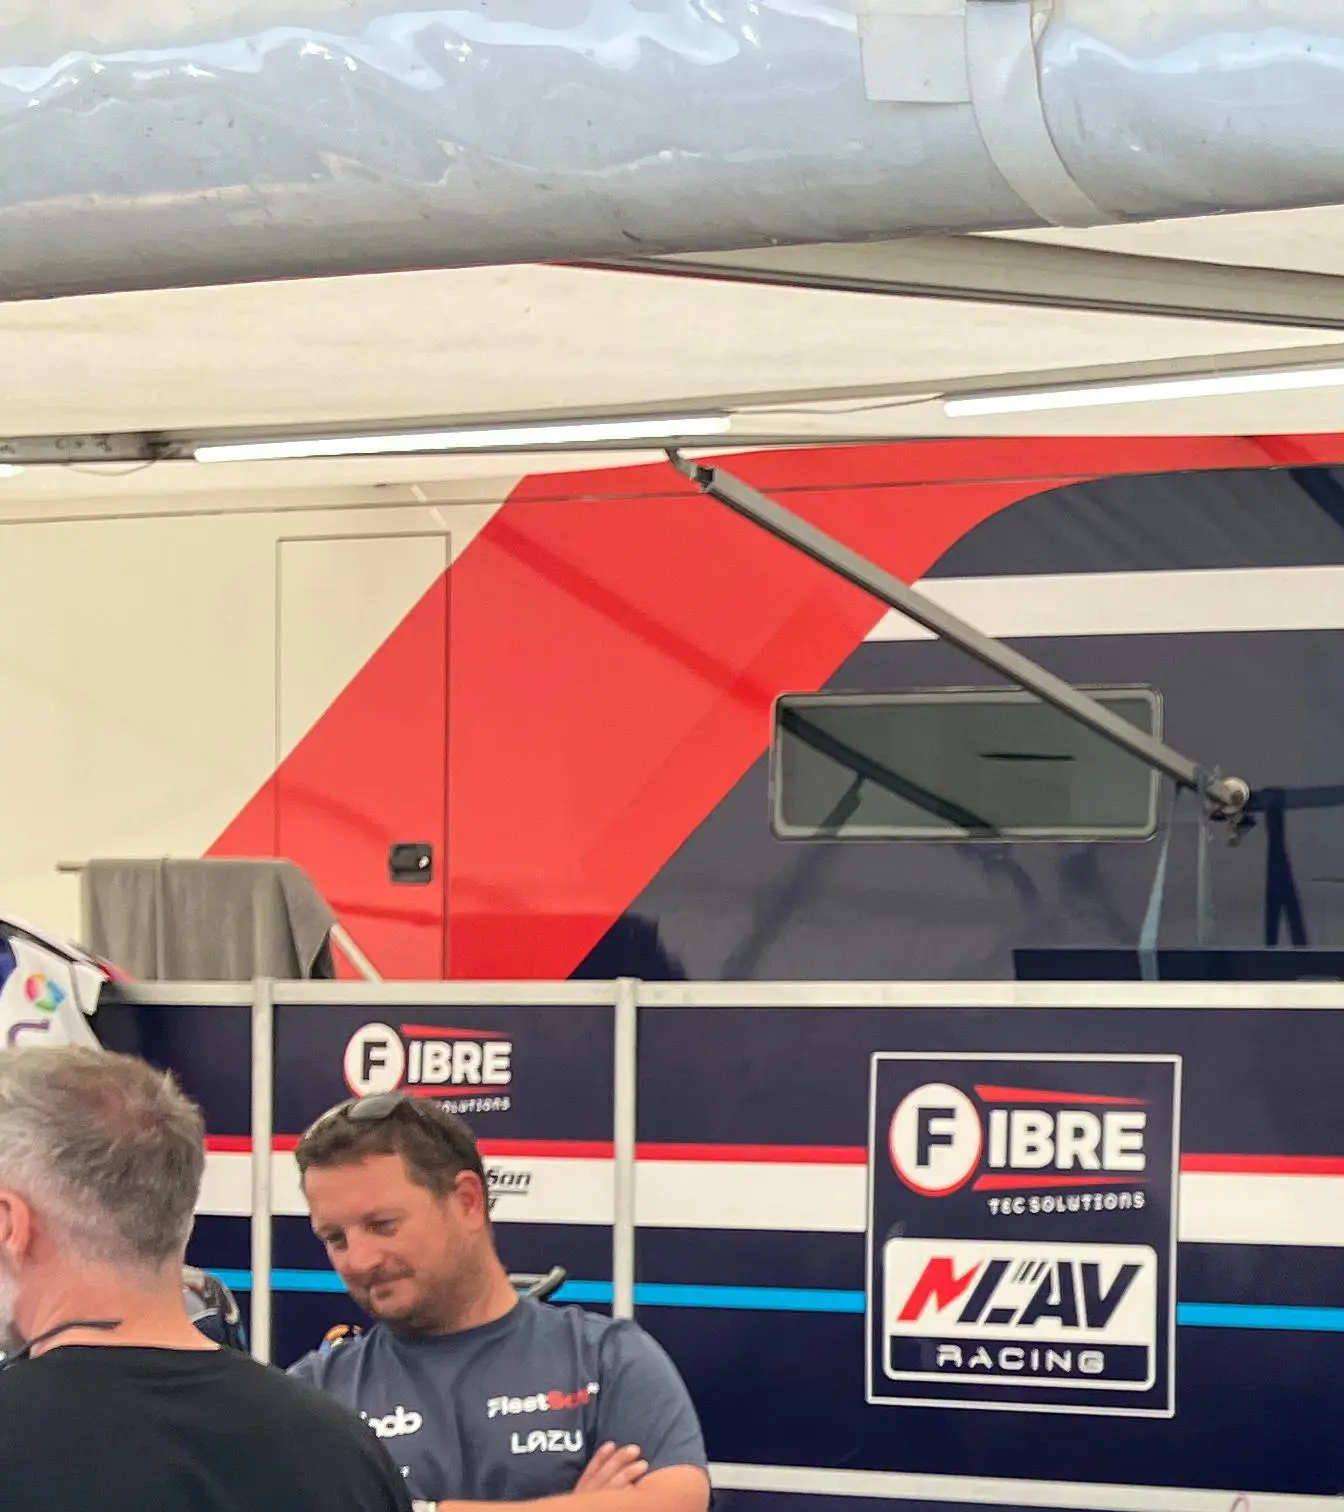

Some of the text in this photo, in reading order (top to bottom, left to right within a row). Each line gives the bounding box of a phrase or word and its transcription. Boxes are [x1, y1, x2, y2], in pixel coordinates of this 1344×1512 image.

[360, 1037, 512, 1085] FIBRE
[915, 1106, 1147, 1171] FIBRE
[936, 1344, 1106, 1375] RACING
